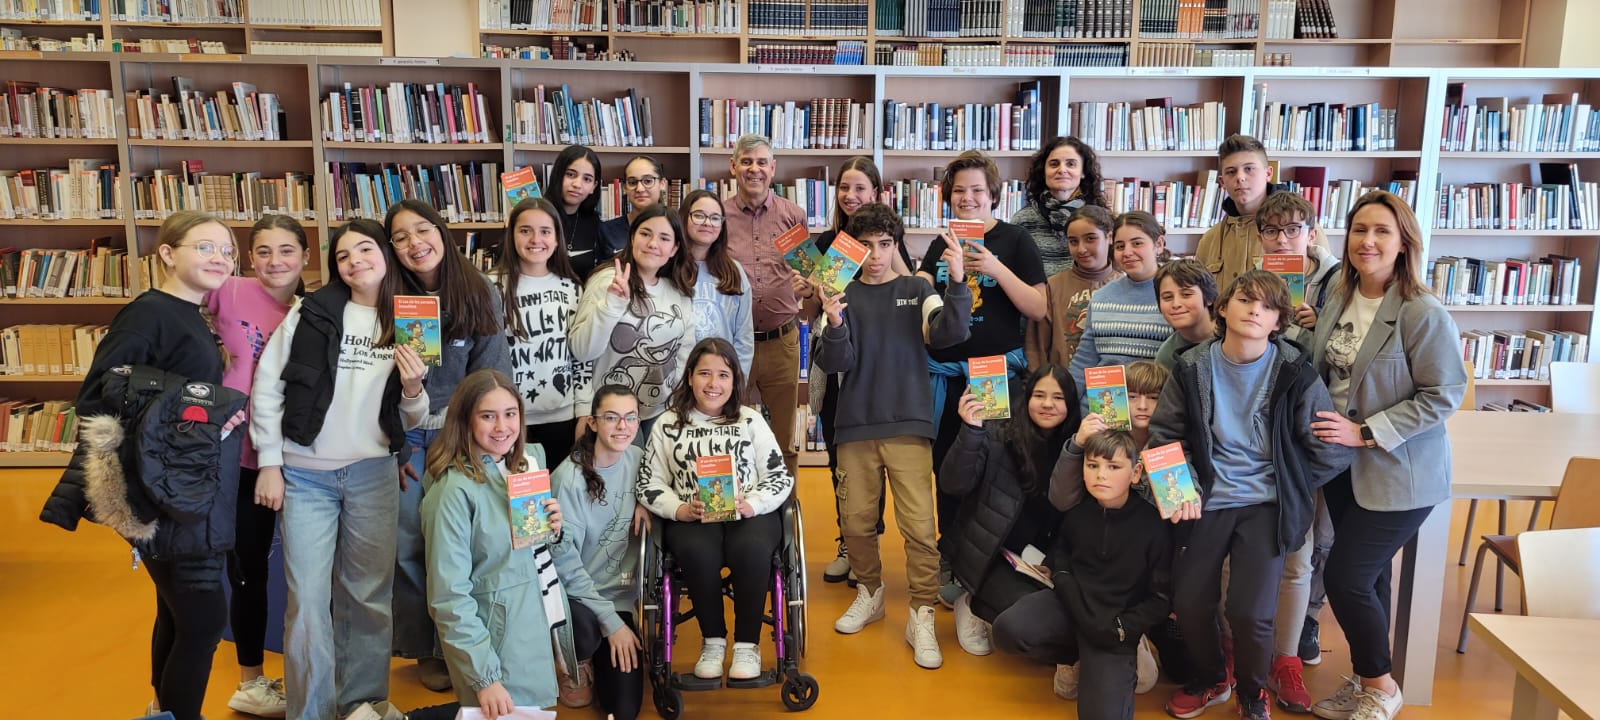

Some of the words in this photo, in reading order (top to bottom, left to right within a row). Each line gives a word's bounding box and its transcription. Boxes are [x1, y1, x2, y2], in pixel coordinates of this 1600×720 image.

[543, 290, 569, 304] STATE
[714, 426, 740, 437] STATE
[725, 438, 752, 464] ME
